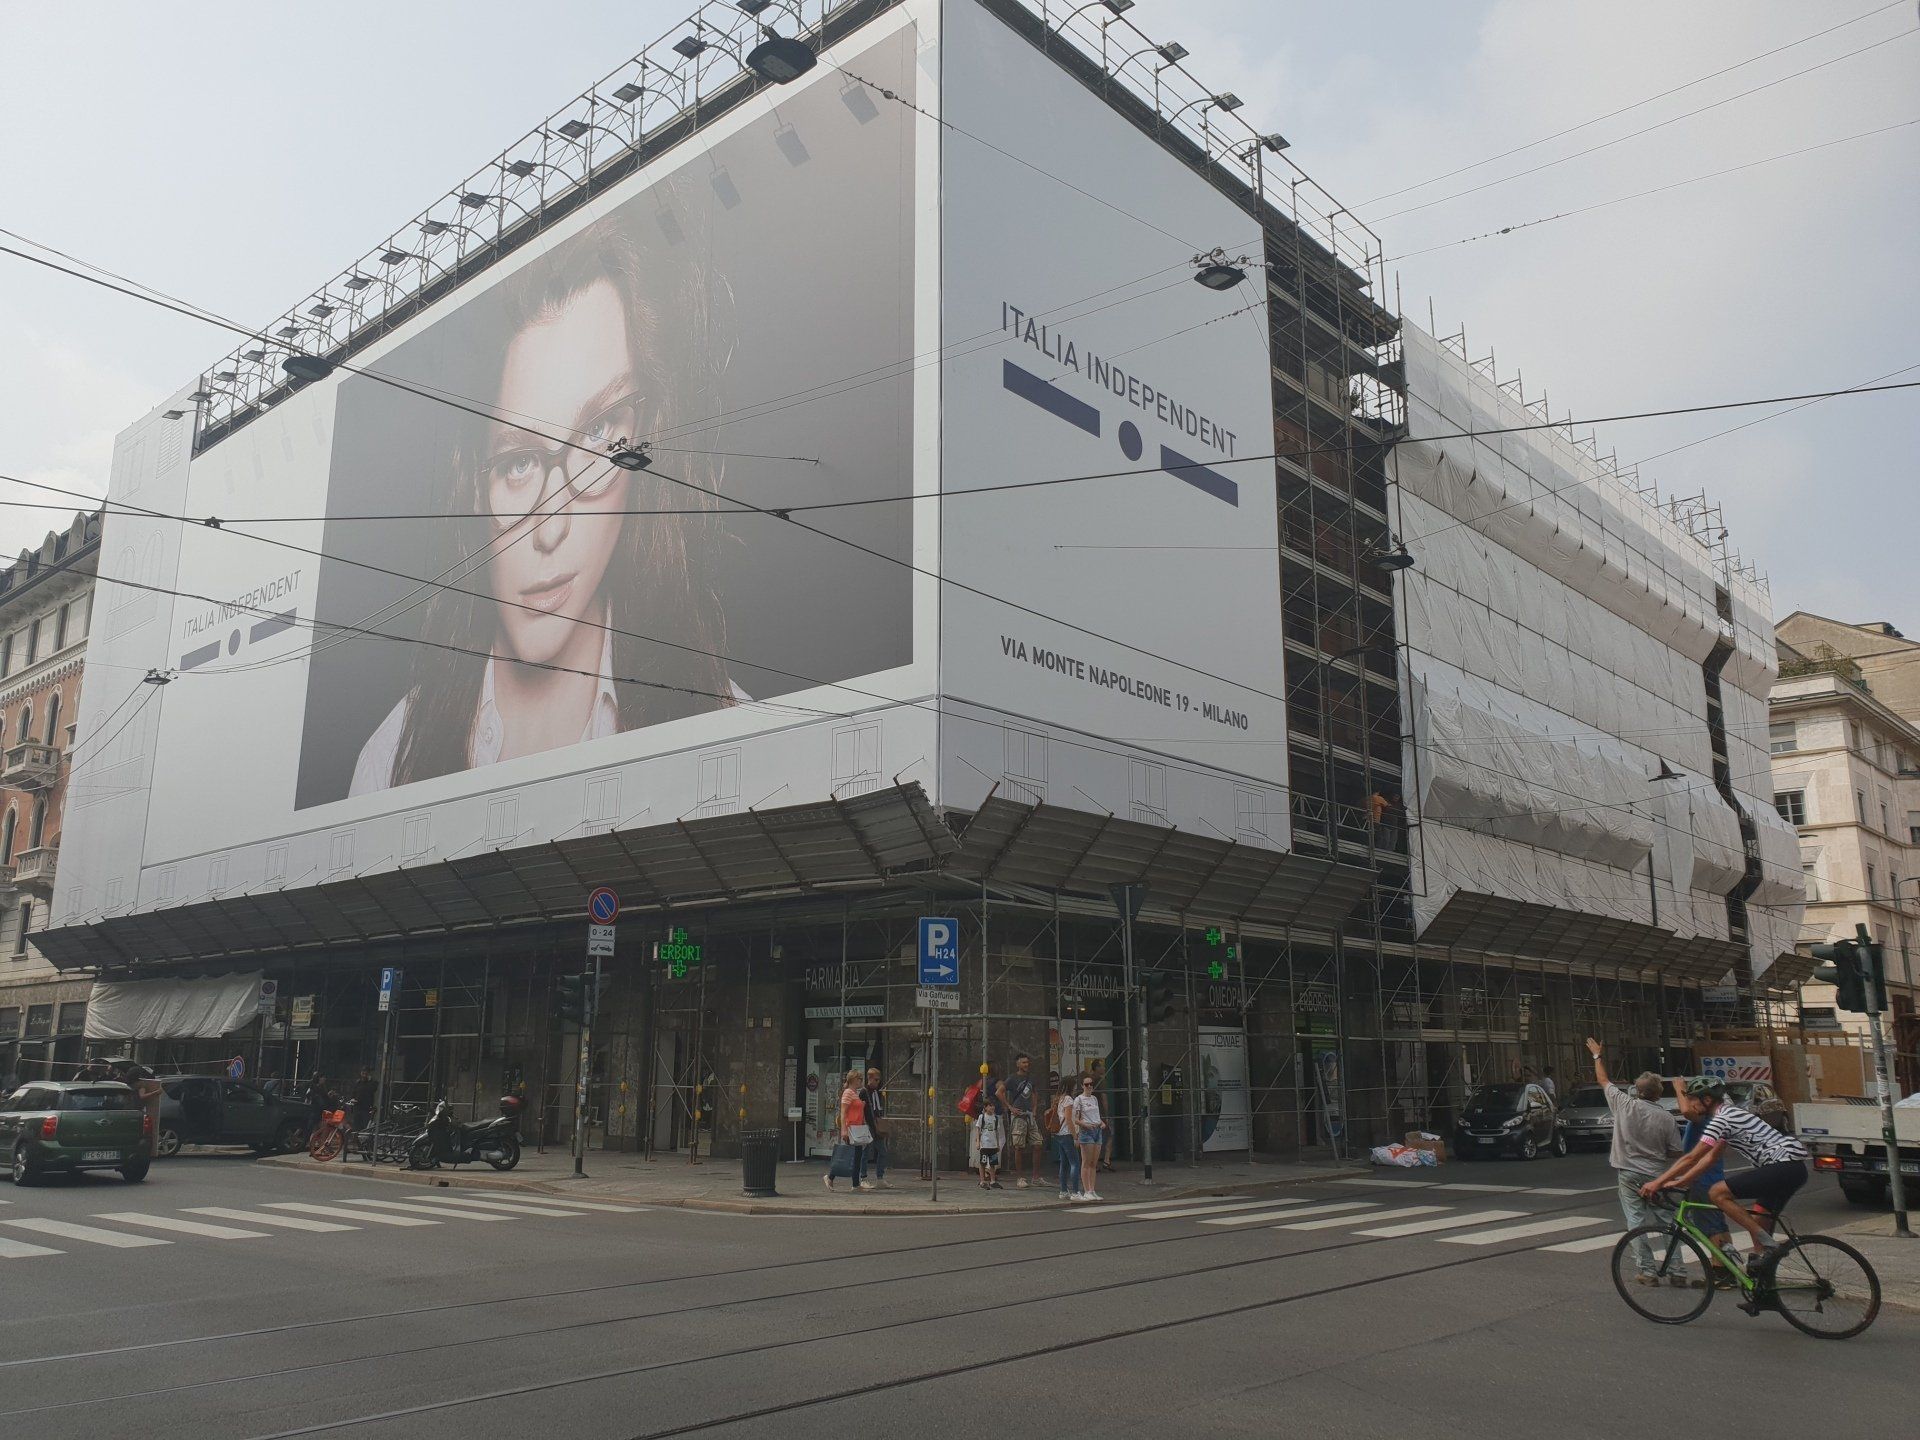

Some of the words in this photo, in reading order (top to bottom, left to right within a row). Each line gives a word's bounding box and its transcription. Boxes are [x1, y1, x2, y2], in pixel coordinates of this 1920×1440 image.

[1002, 301, 1079, 373] ITALIA
[1087, 351, 1237, 458] INDEPENDENT
[183, 609, 215, 639] ITALIA
[218, 569, 302, 624] INDEPENDENT
[1000, 635, 1028, 662] VIA
[1033, 646, 1085, 680] MONTE
[1089, 665, 1171, 707] NAPOLEONE
[1176, 693, 1189, 713] 19
[1202, 701, 1248, 731] MILANO
[928, 923, 950, 957] P
[660, 945, 701, 961] ERBORI
[935, 948, 955, 960] H24
[383, 970, 391, 989] P
[805, 965, 860, 991] FARMACIA
[918, 990, 928, 998] Via
[929, 990, 954, 1000] Gaffurio
[928, 999, 939, 1008] 100
